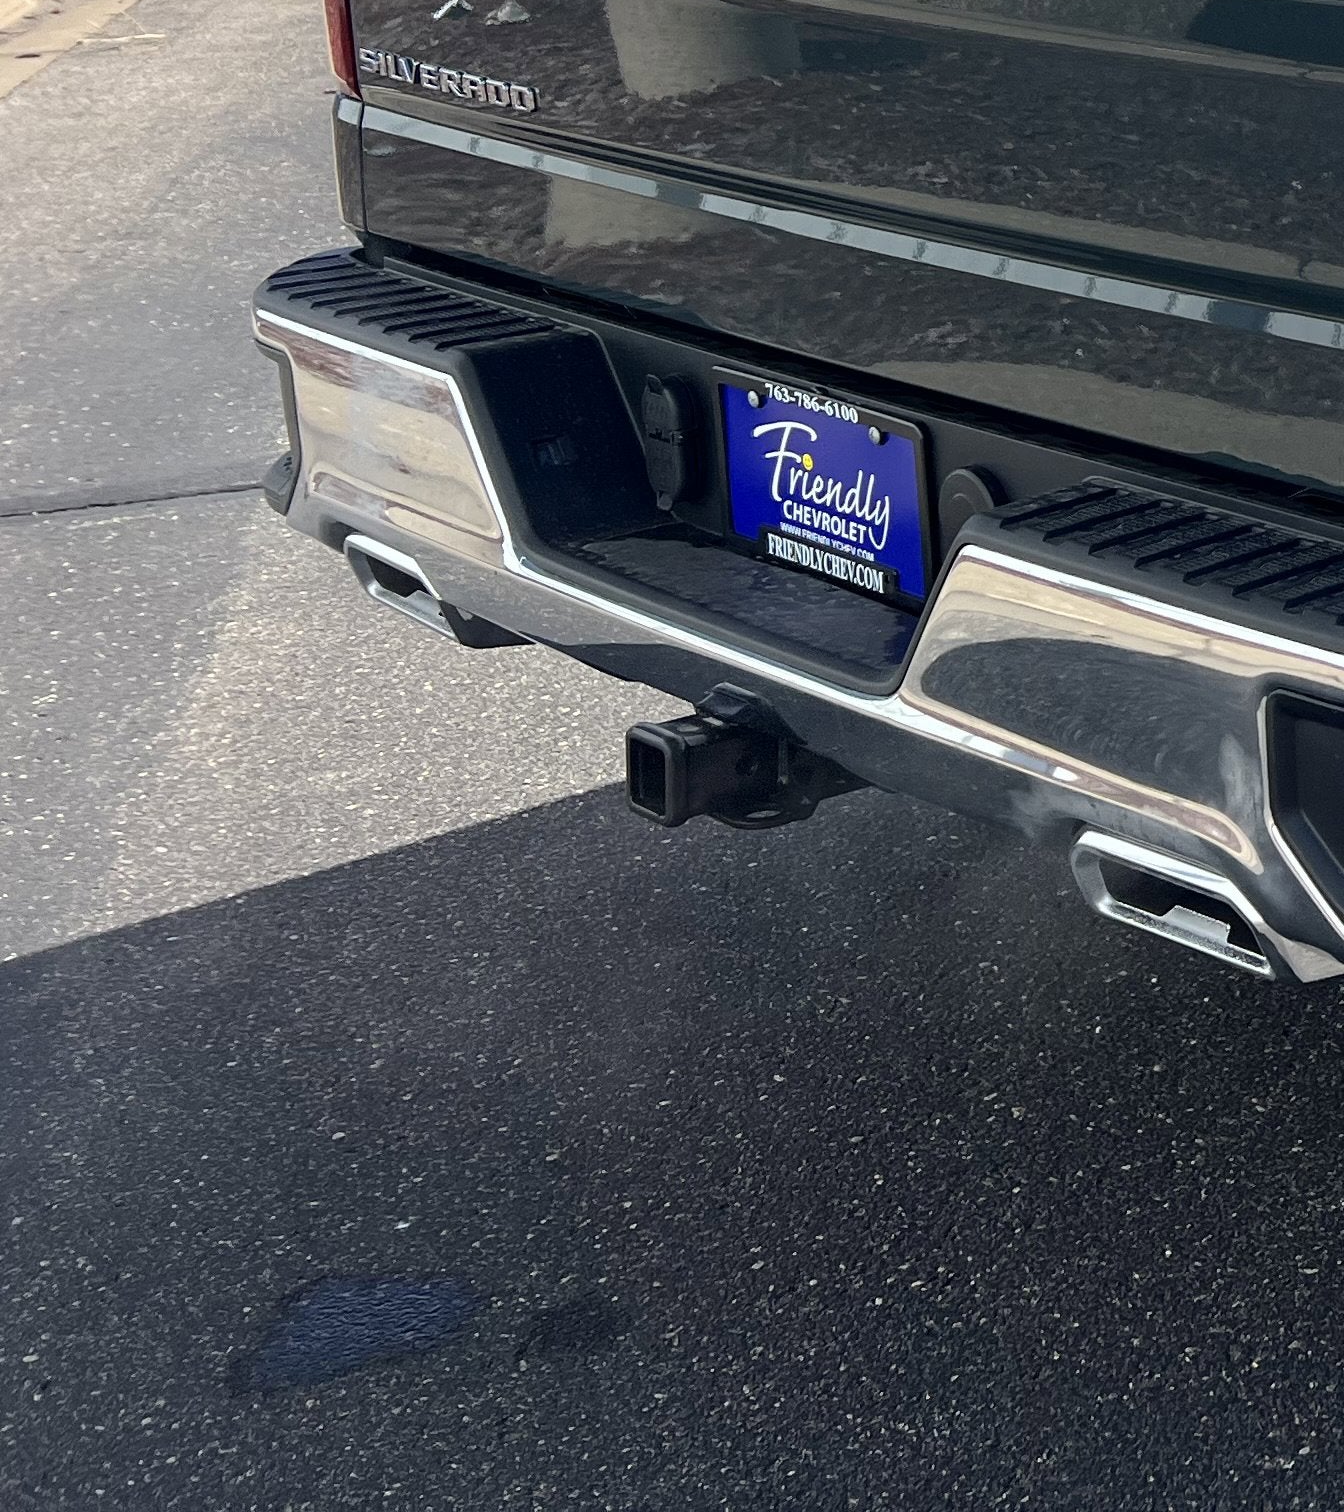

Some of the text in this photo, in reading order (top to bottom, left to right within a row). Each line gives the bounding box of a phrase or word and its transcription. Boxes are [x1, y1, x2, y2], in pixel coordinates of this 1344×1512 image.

[359, 47, 540, 113] SILVERADO
[764, 382, 859, 424] 763-786-6100
[753, 421, 890, 550] Friendly
[782, 499, 868, 544] CHEVROLET
[766, 532, 885, 594] FRIENDLYCHEV.COM
